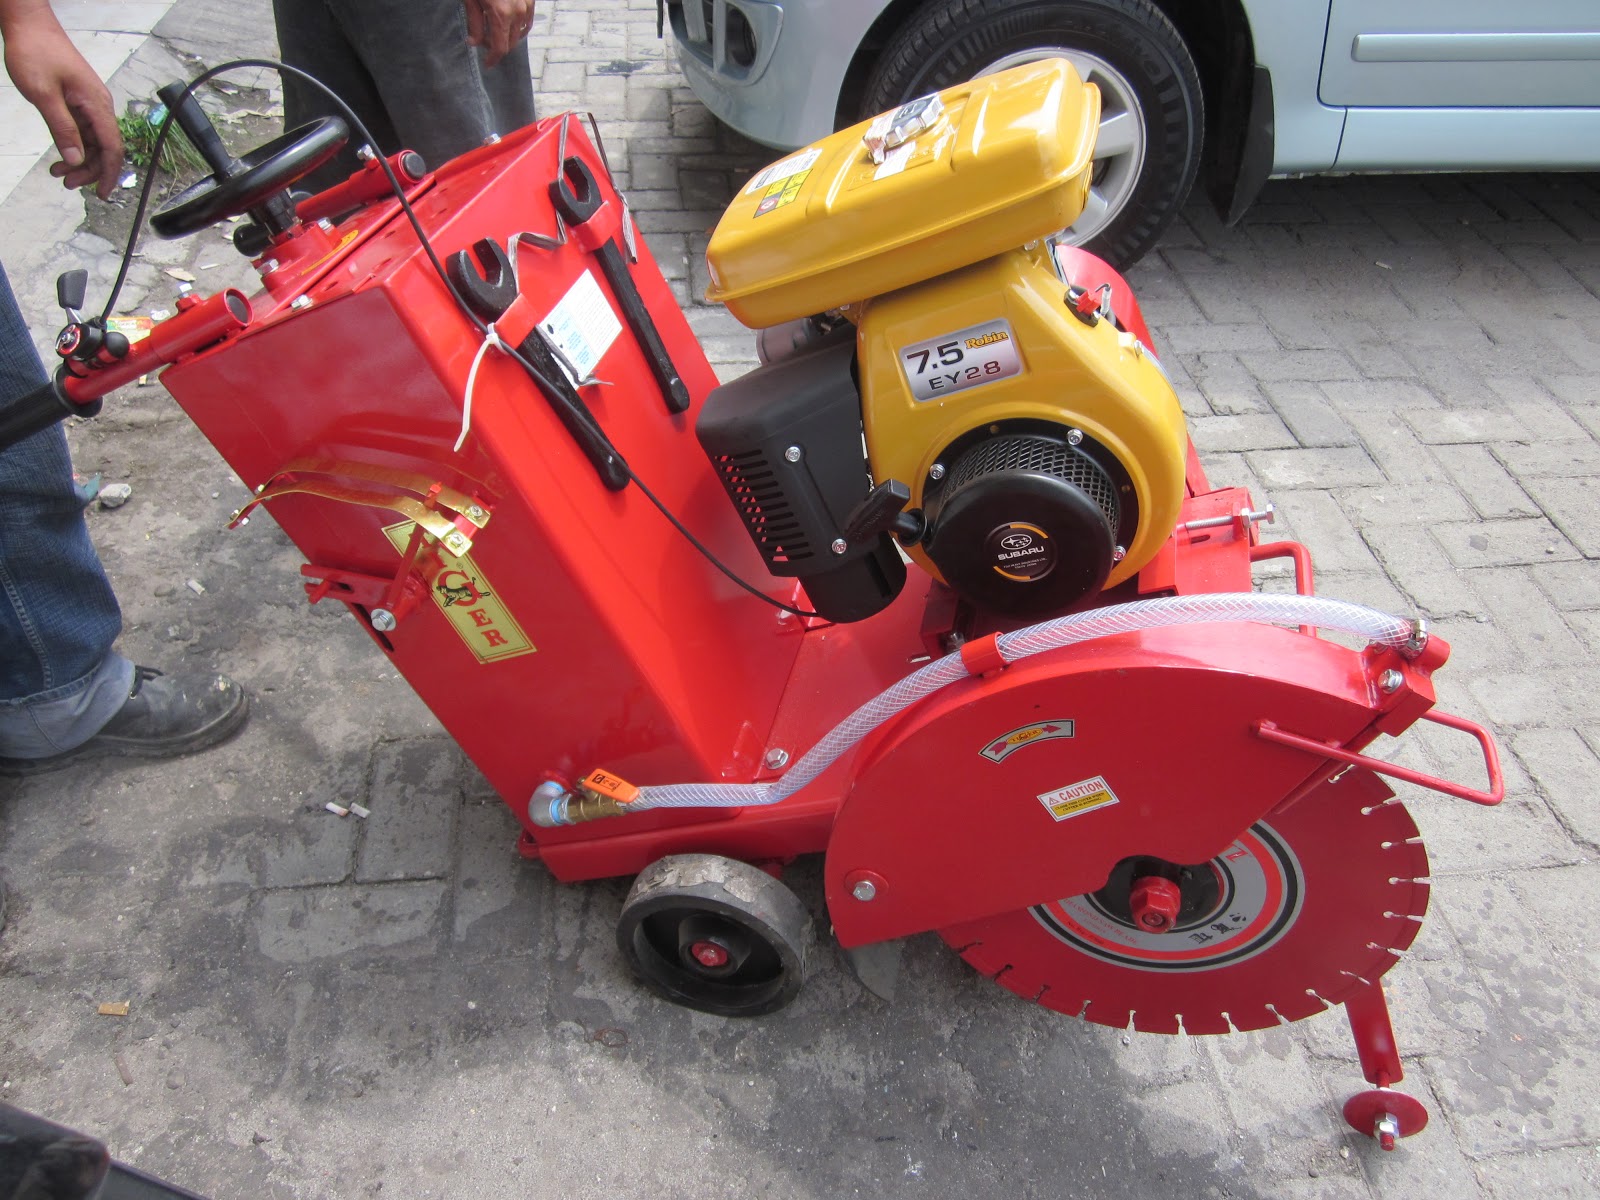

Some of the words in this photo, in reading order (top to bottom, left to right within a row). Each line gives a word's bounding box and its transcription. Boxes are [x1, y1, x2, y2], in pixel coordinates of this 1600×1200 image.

[906, 341, 964, 375] 7.5
[964, 331, 1009, 350] Robin
[929, 360, 1001, 390] EY28
[998, 546, 1045, 561] SUBARU
[1058, 780, 1104, 801] CAUTION
